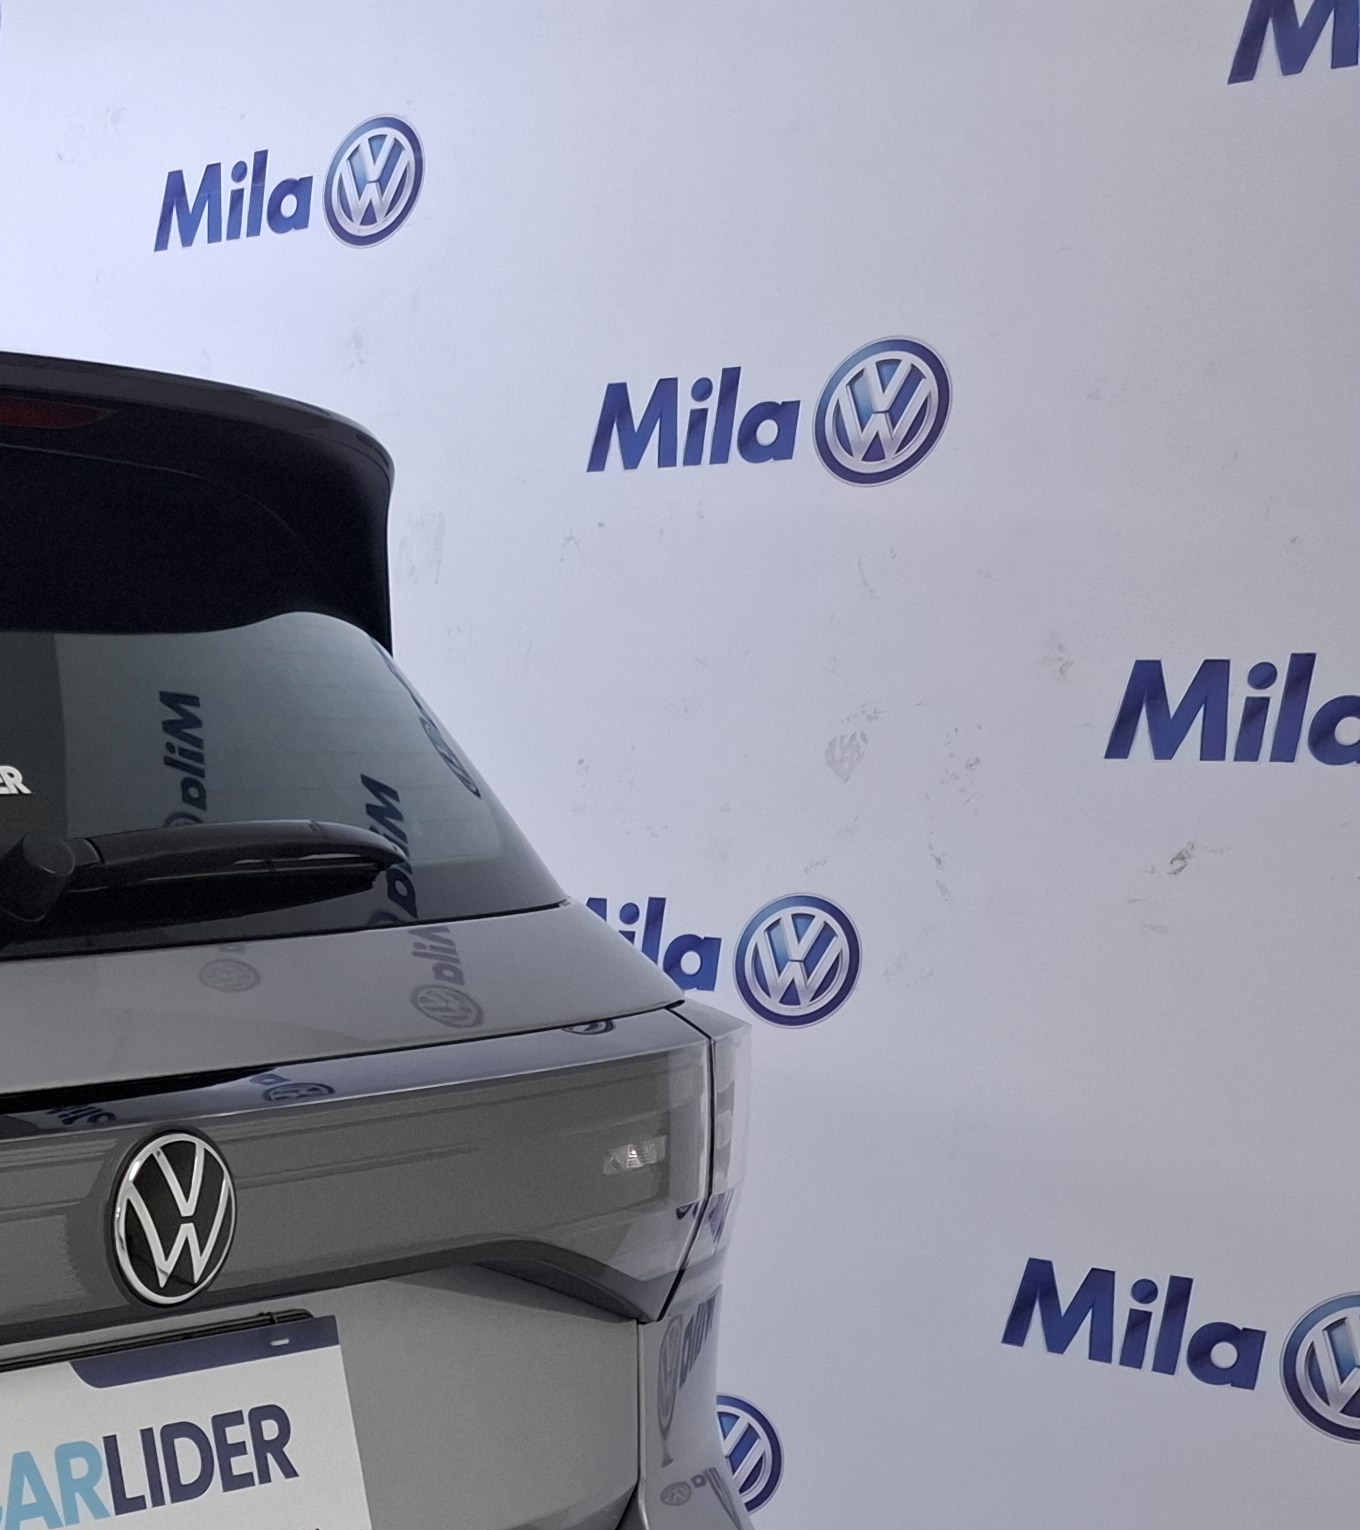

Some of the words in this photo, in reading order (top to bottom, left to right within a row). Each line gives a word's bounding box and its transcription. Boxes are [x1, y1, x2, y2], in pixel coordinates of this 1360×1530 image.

[153, 149, 314, 252] Mila
[586, 366, 801, 472] Mila
[1103, 652, 1360, 765] Mila
[111, 1129, 237, 1308] VW
[1000, 1256, 1267, 1391] Mila
